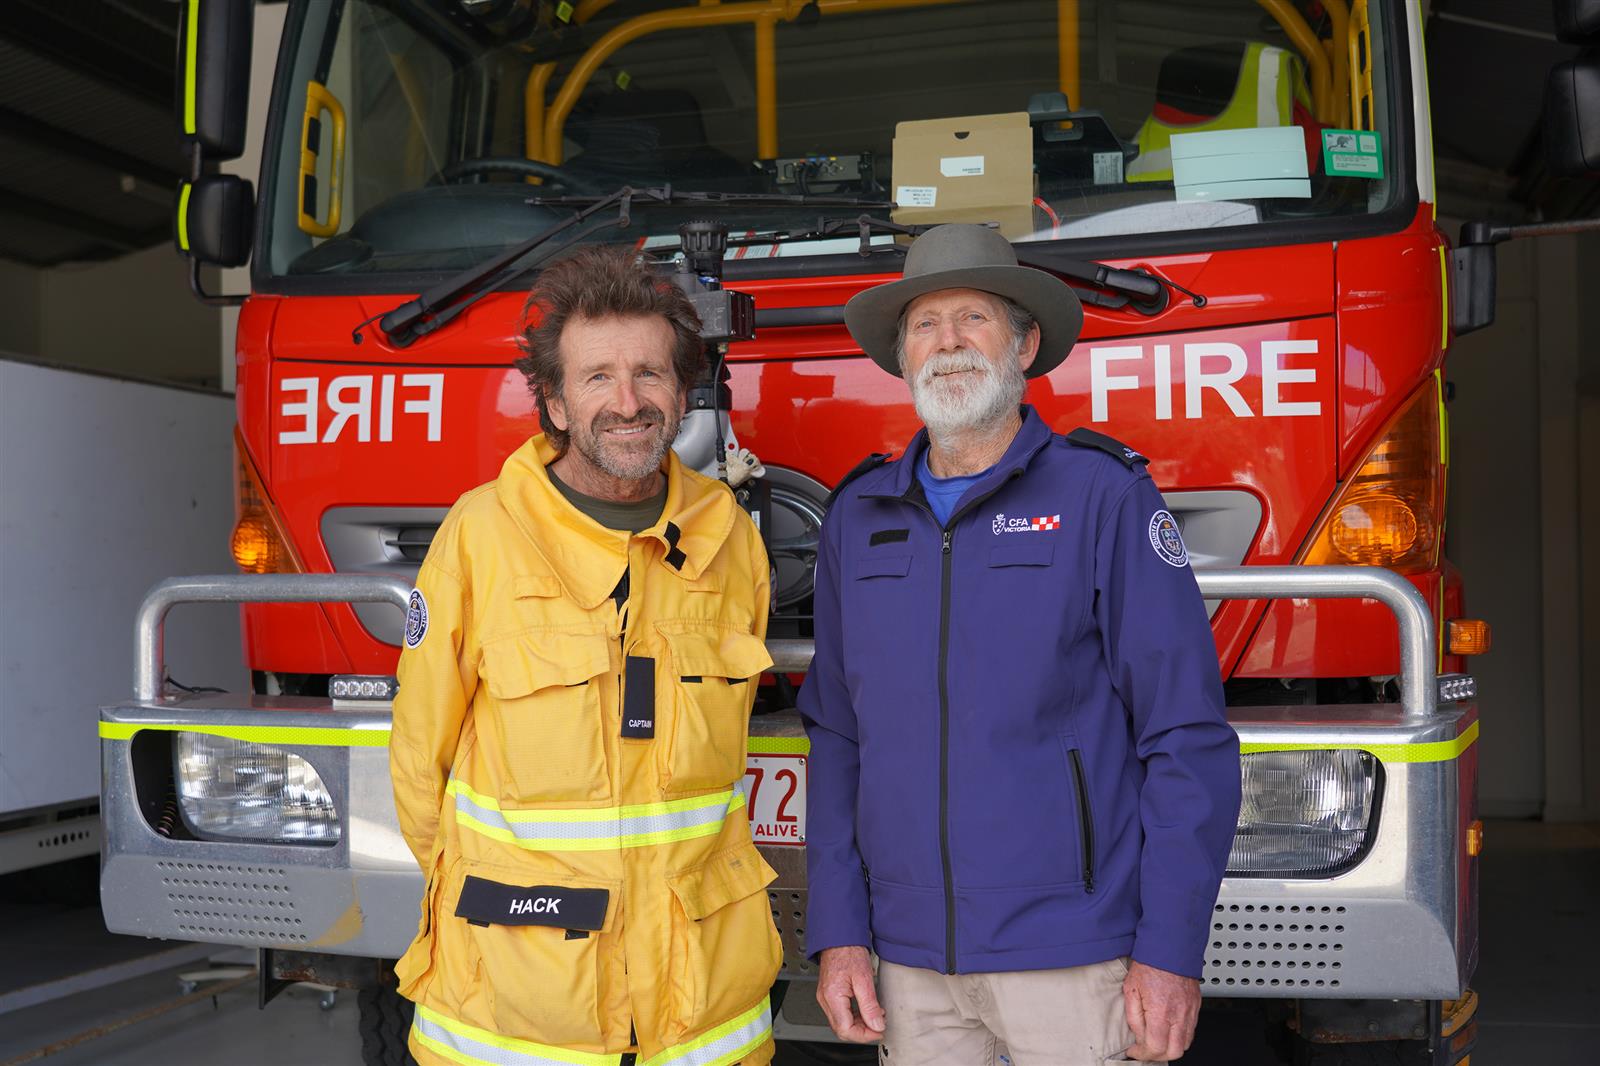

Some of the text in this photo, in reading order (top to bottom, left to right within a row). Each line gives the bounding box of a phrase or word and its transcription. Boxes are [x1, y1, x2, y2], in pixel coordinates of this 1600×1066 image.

[1090, 340, 1321, 422] FIRE
[1004, 525, 1031, 533] VICTORIA
[1008, 517, 1029, 527] CFA
[628, 719, 652, 729] CAPTAIN
[745, 767, 798, 823] 72
[755, 823, 798, 837] ALIVE
[509, 897, 562, 915] HACK
